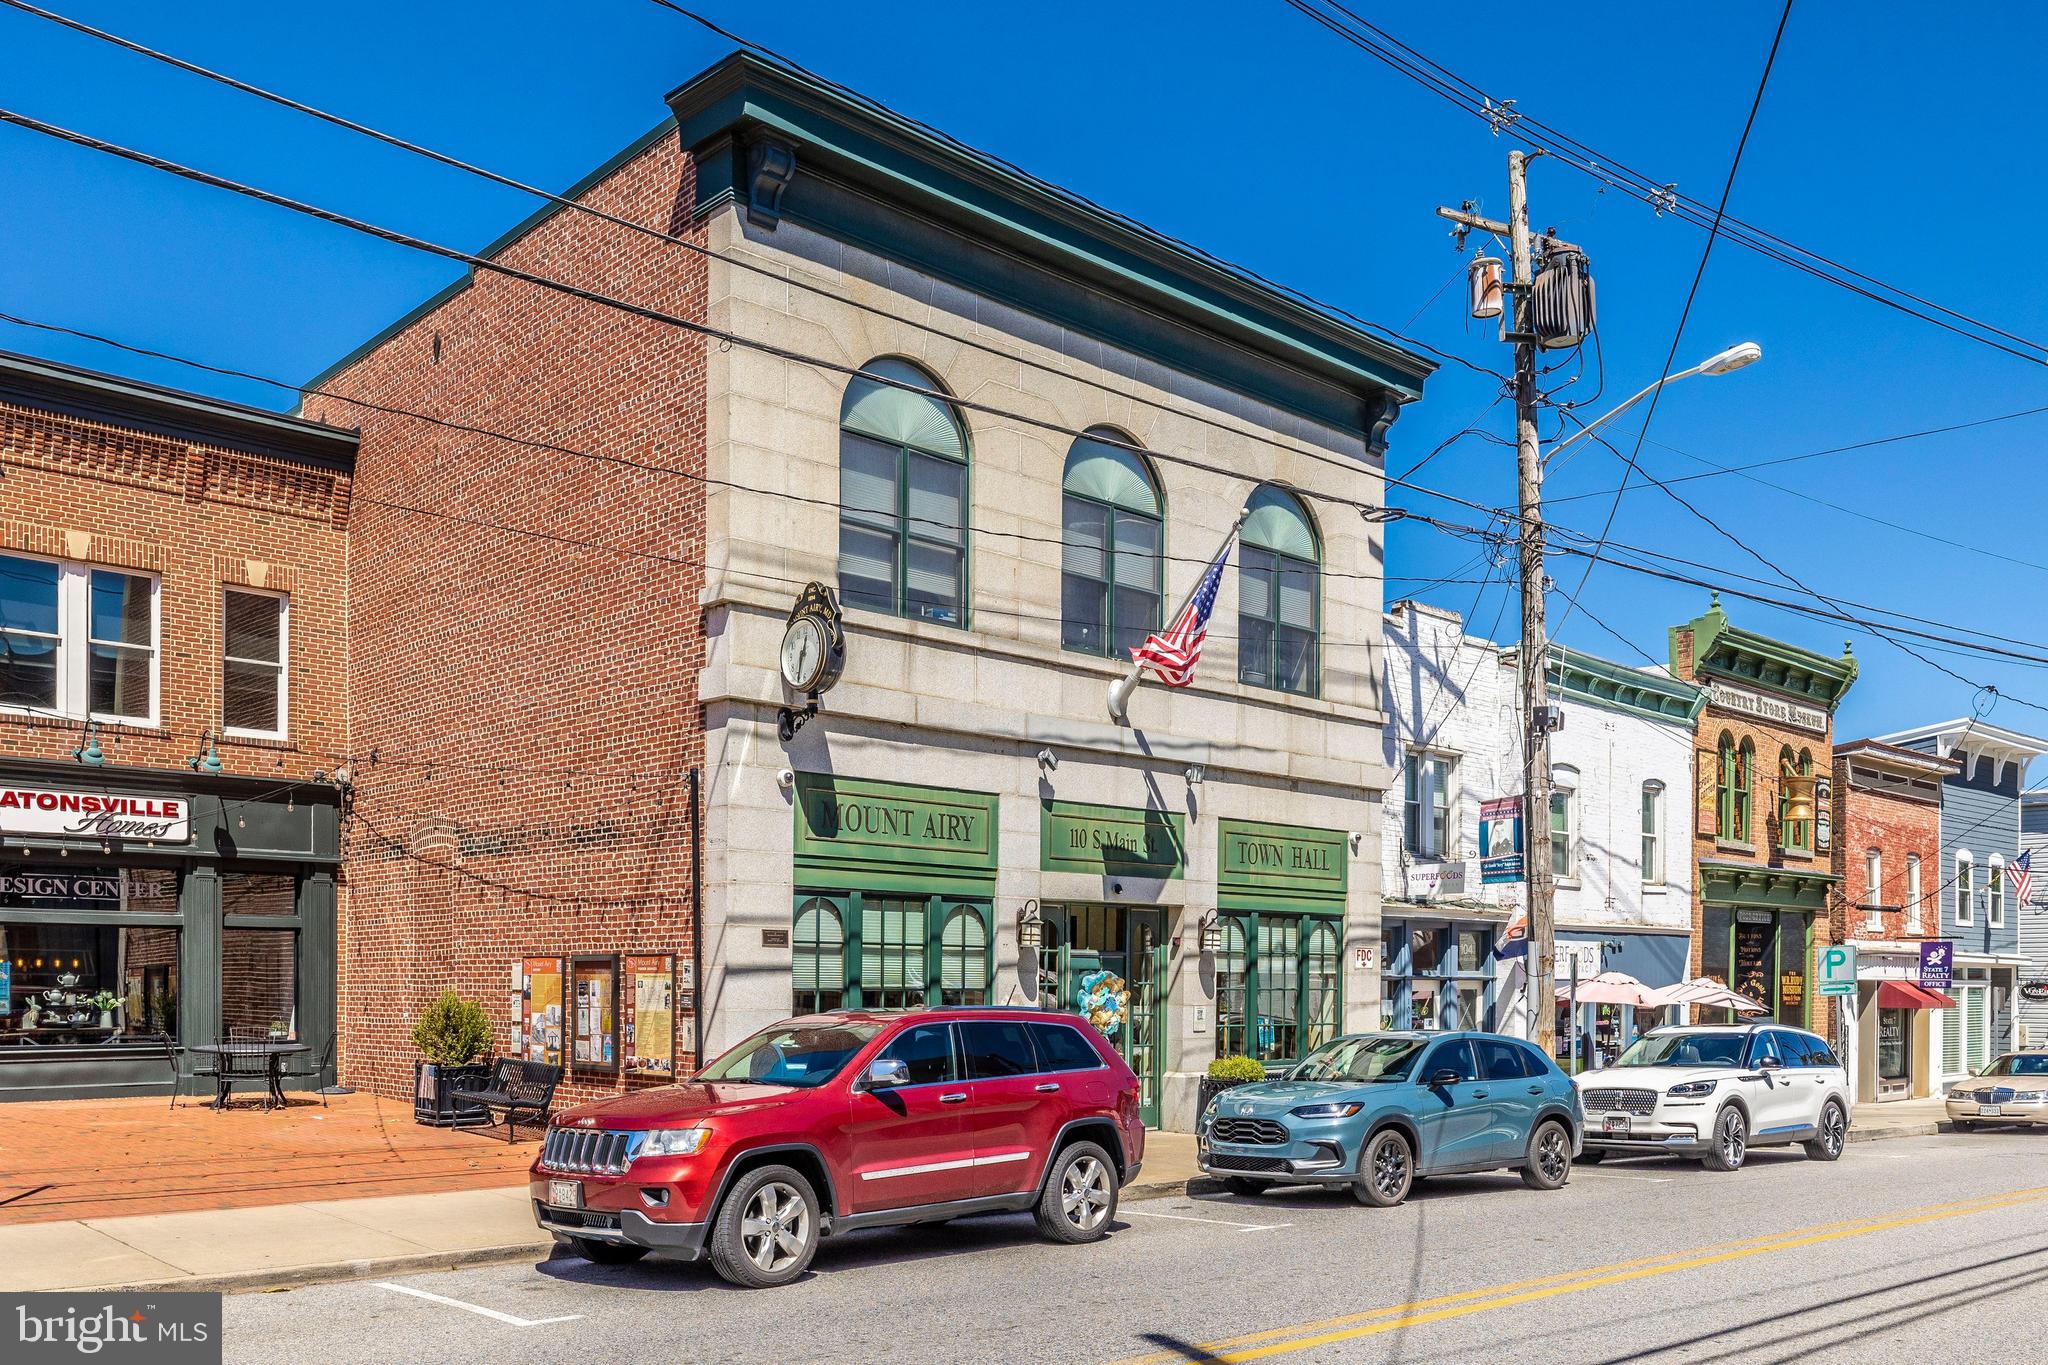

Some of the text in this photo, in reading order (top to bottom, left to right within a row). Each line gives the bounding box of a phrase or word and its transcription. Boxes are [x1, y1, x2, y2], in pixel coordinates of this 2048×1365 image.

[63, 810, 172, 837] Homes
[822, 801, 975, 842] MOUNT AIRY
[1069, 828, 1087, 849] 110
[1105, 831, 1138, 853] Main
[1238, 842, 1330, 871] TOWN HALL
[0, 877, 163, 898] ESIGN CENTER
[1410, 870, 1464, 881] SUPERFOODS
[1356, 949, 1372, 961] FDC
[1826, 950, 1846, 978] P
[1879, 1025, 1900, 1037] REALTY
